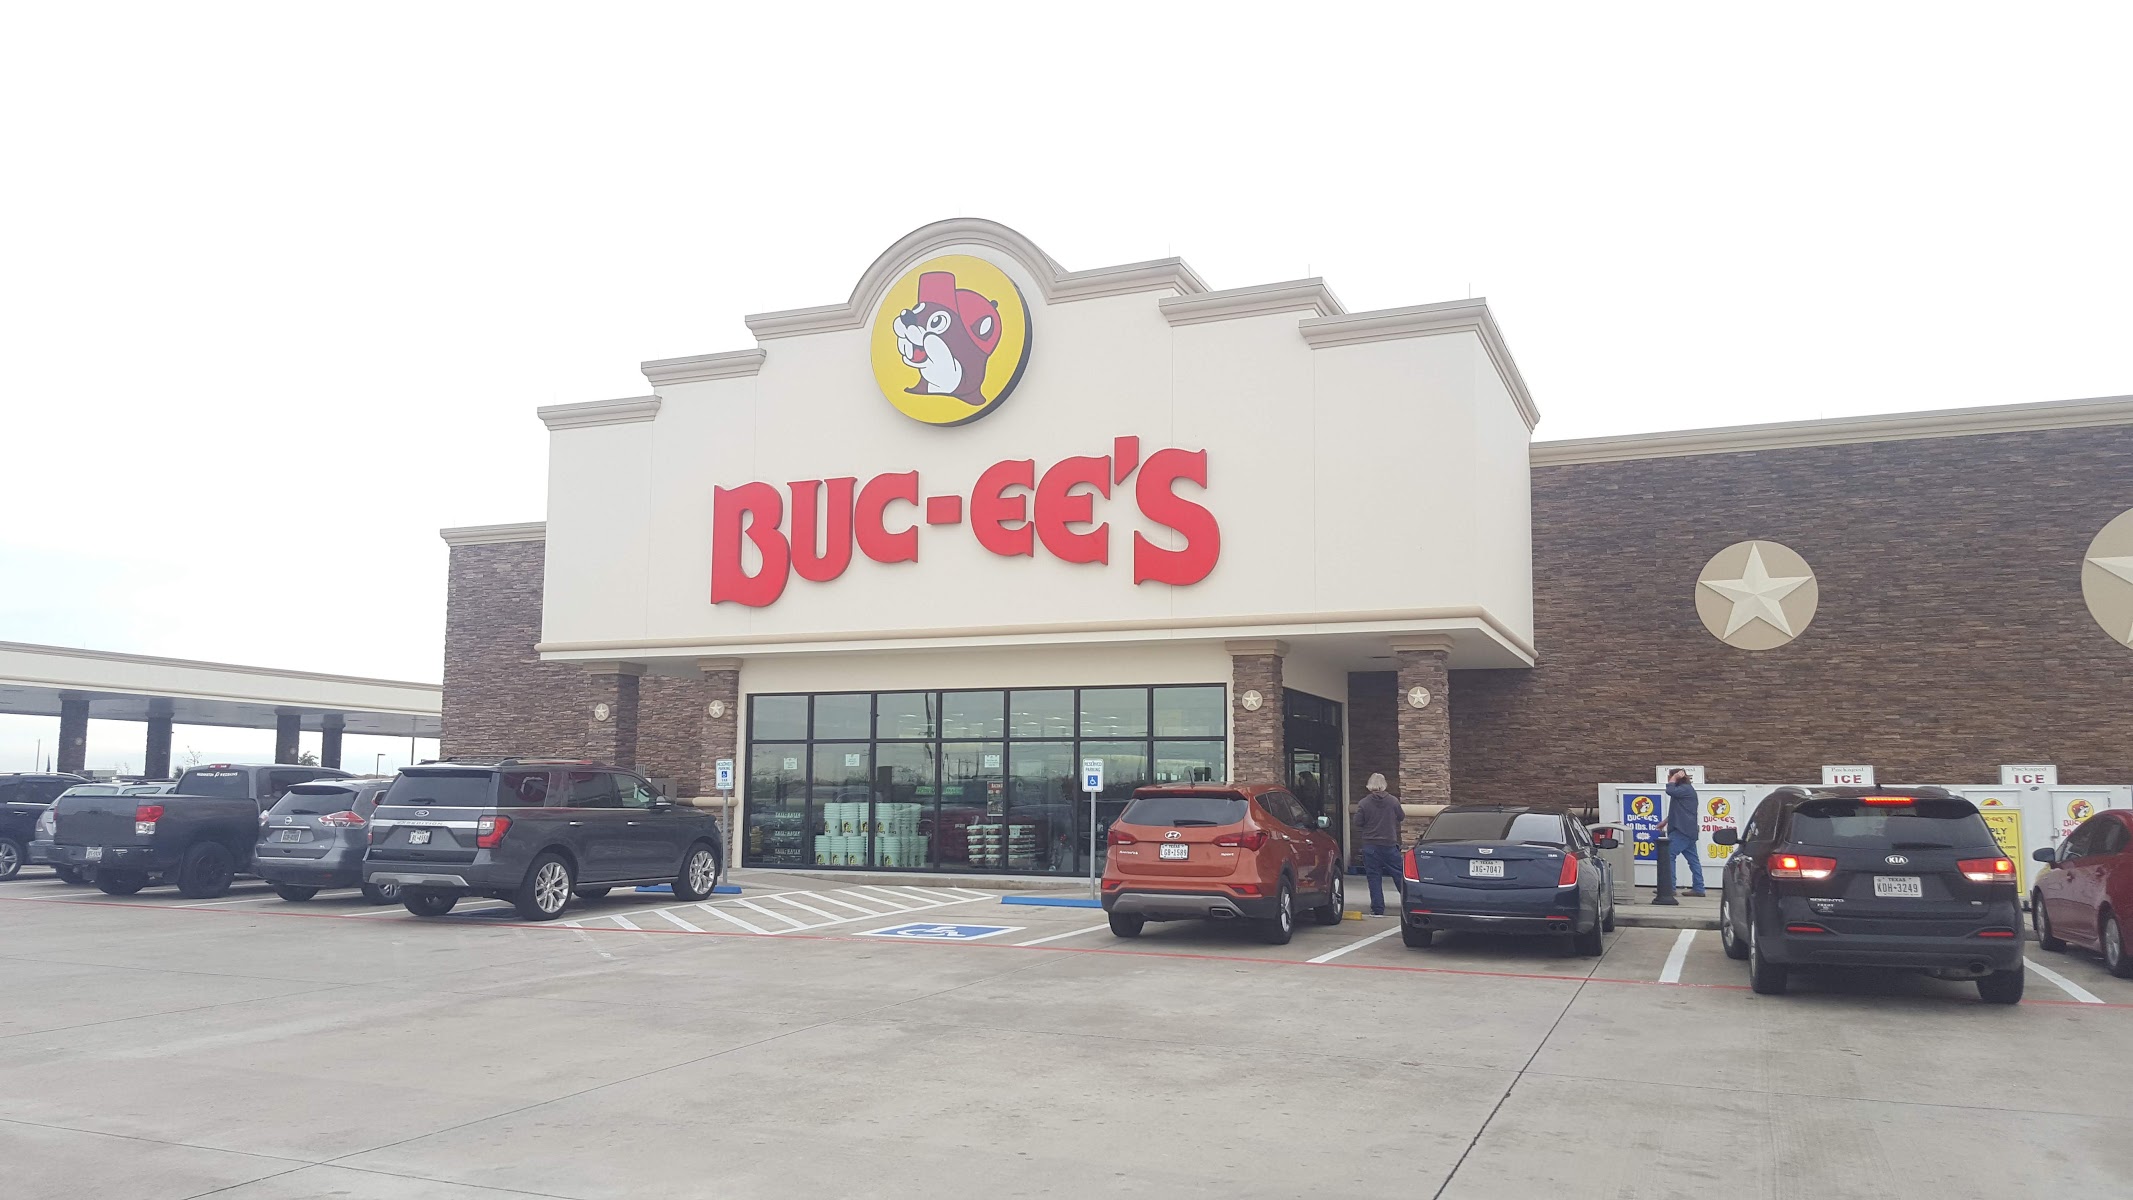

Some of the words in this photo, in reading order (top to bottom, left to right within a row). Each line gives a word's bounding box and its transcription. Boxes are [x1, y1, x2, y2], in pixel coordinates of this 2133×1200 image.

[711, 436, 1221, 608] BUC-EE'S
[1833, 774, 1862, 784] ICE
[2014, 774, 2045, 784] ICE
[1888, 856, 1905, 864] KIA
